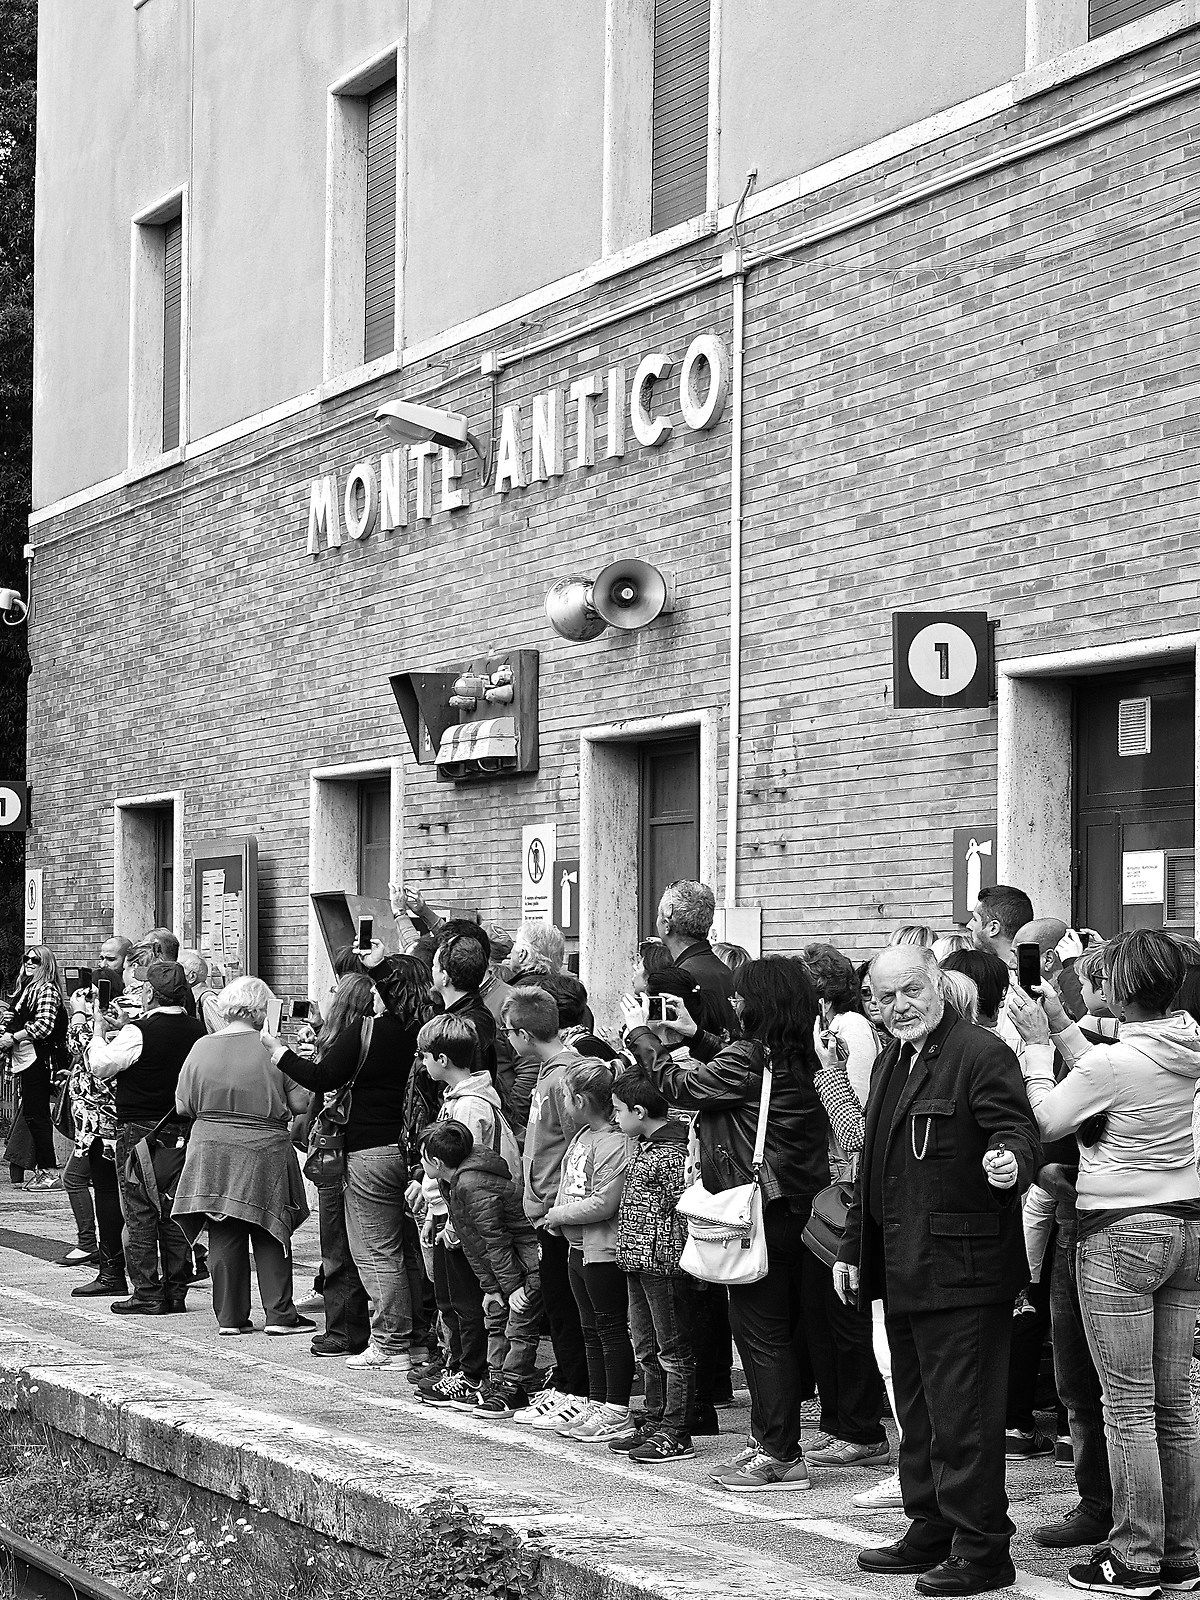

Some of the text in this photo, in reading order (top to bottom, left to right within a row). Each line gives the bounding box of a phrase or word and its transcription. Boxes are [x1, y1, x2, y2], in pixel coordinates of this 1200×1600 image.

[307, 333, 730, 555] MONTE ANTICO
[934, 642, 950, 680] 1
